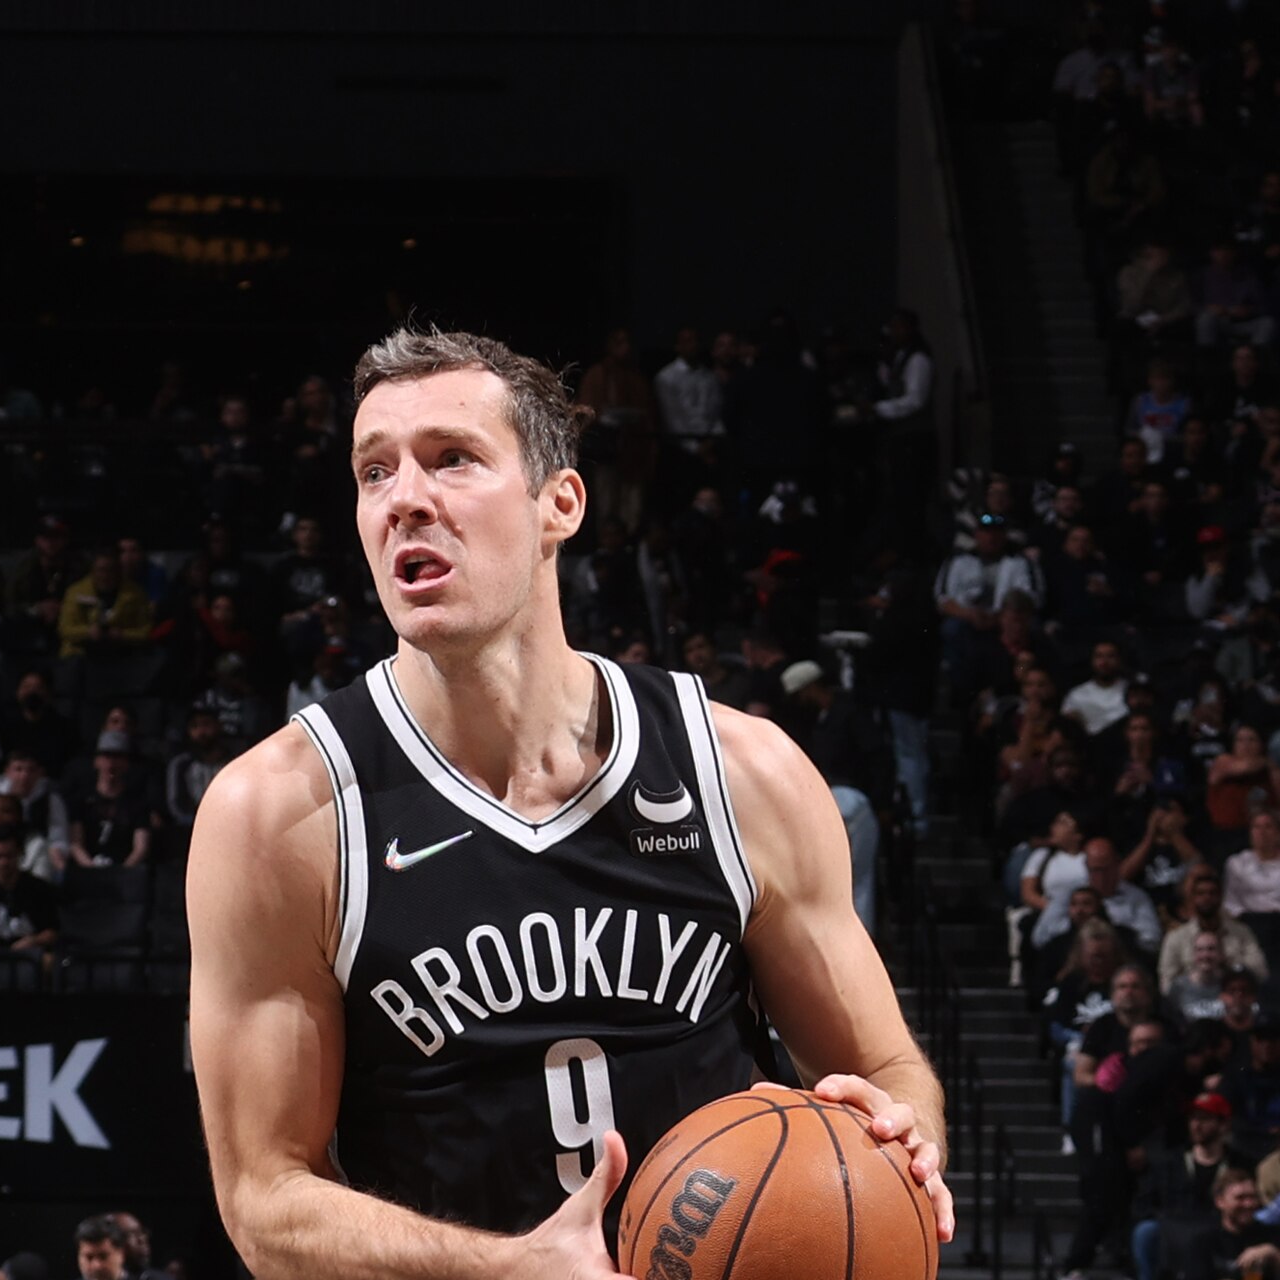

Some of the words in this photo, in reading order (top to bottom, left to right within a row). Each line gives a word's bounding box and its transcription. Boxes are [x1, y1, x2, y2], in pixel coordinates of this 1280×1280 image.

[637, 832, 701, 852] Webull
[370, 907, 731, 1057] BROOKLYN
[544, 1038, 617, 1196] 9
